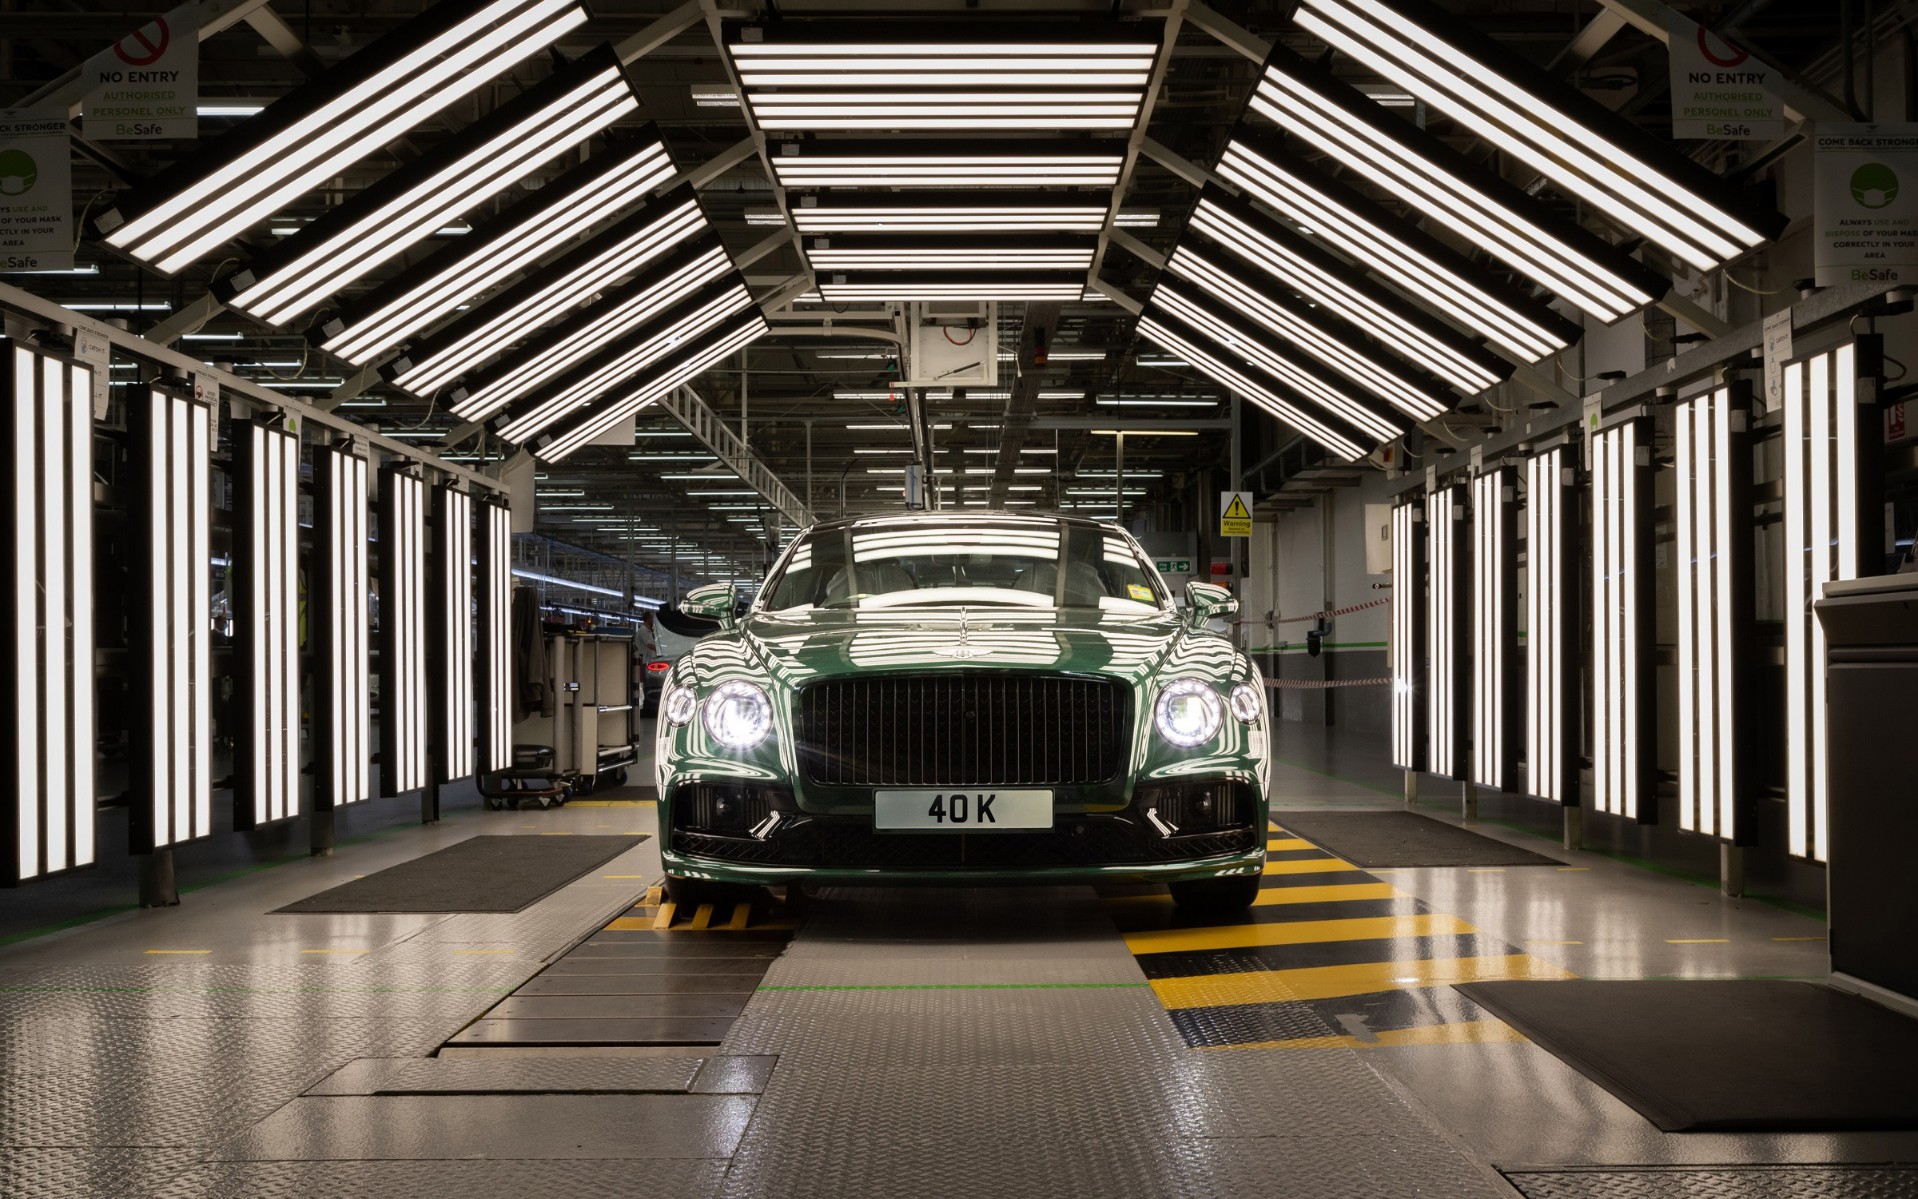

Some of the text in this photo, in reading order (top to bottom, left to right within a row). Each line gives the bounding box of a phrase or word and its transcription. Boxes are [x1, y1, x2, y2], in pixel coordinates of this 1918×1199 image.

[100, 71, 179, 83] NO ENTRY
[1689, 72, 1765, 84] NO ENTRY
[103, 90, 176, 101] AUTHORISED
[1693, 92, 1763, 101] AUTHORISED
[93, 106, 185, 117] PERSONEL ONLY
[1683, 107, 1773, 117] PERSONEL ONLY
[0, 122, 66, 132] CK STRONGER
[116, 123, 162, 135] BeSafe
[1706, 123, 1751, 136] BeSafe
[1818, 138, 1918, 146] COME BACK STRONGE
[15, 216, 37, 224] YOUR
[39, 215, 62, 223] MASK
[1825, 230, 1860, 238] DISPOSE
[2, 239, 25, 247] AREA
[1833, 241, 1880, 249] CORRECTLY
[0, 256, 38, 268] eSafe
[1851, 268, 1898, 281] BeSafe
[1223, 520, 1251, 528] Warning
[929, 794, 996, 823] 40 K
